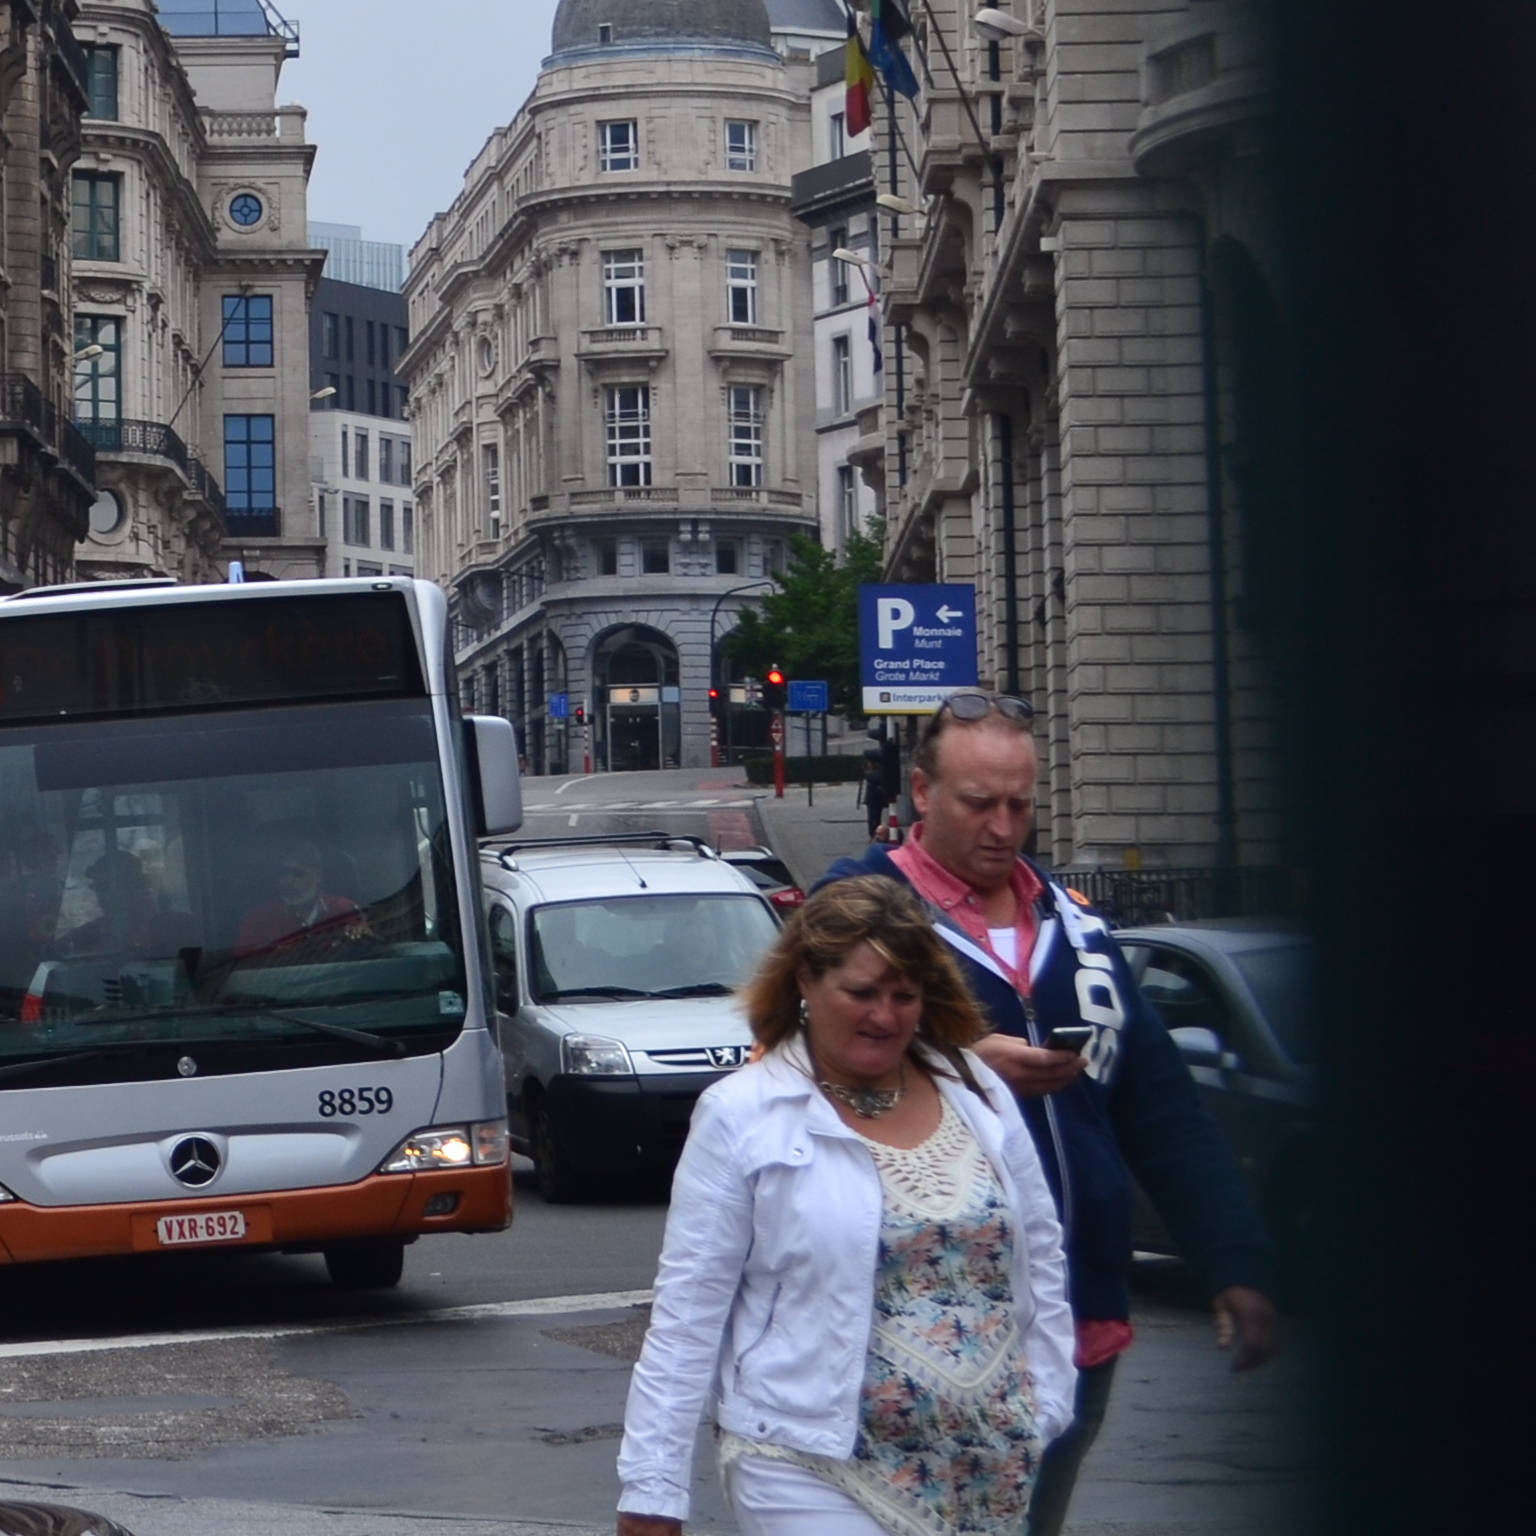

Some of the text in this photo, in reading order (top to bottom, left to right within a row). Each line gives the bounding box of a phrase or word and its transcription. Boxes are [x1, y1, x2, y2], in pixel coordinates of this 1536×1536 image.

[877, 597, 915, 649] P
[912, 626, 963, 637] Monnaie
[914, 638, 943, 649] Munt
[873, 658, 946, 669] Grand Place
[875, 671, 941, 682] Grote Markt
[318, 1086, 393, 1118] 8859
